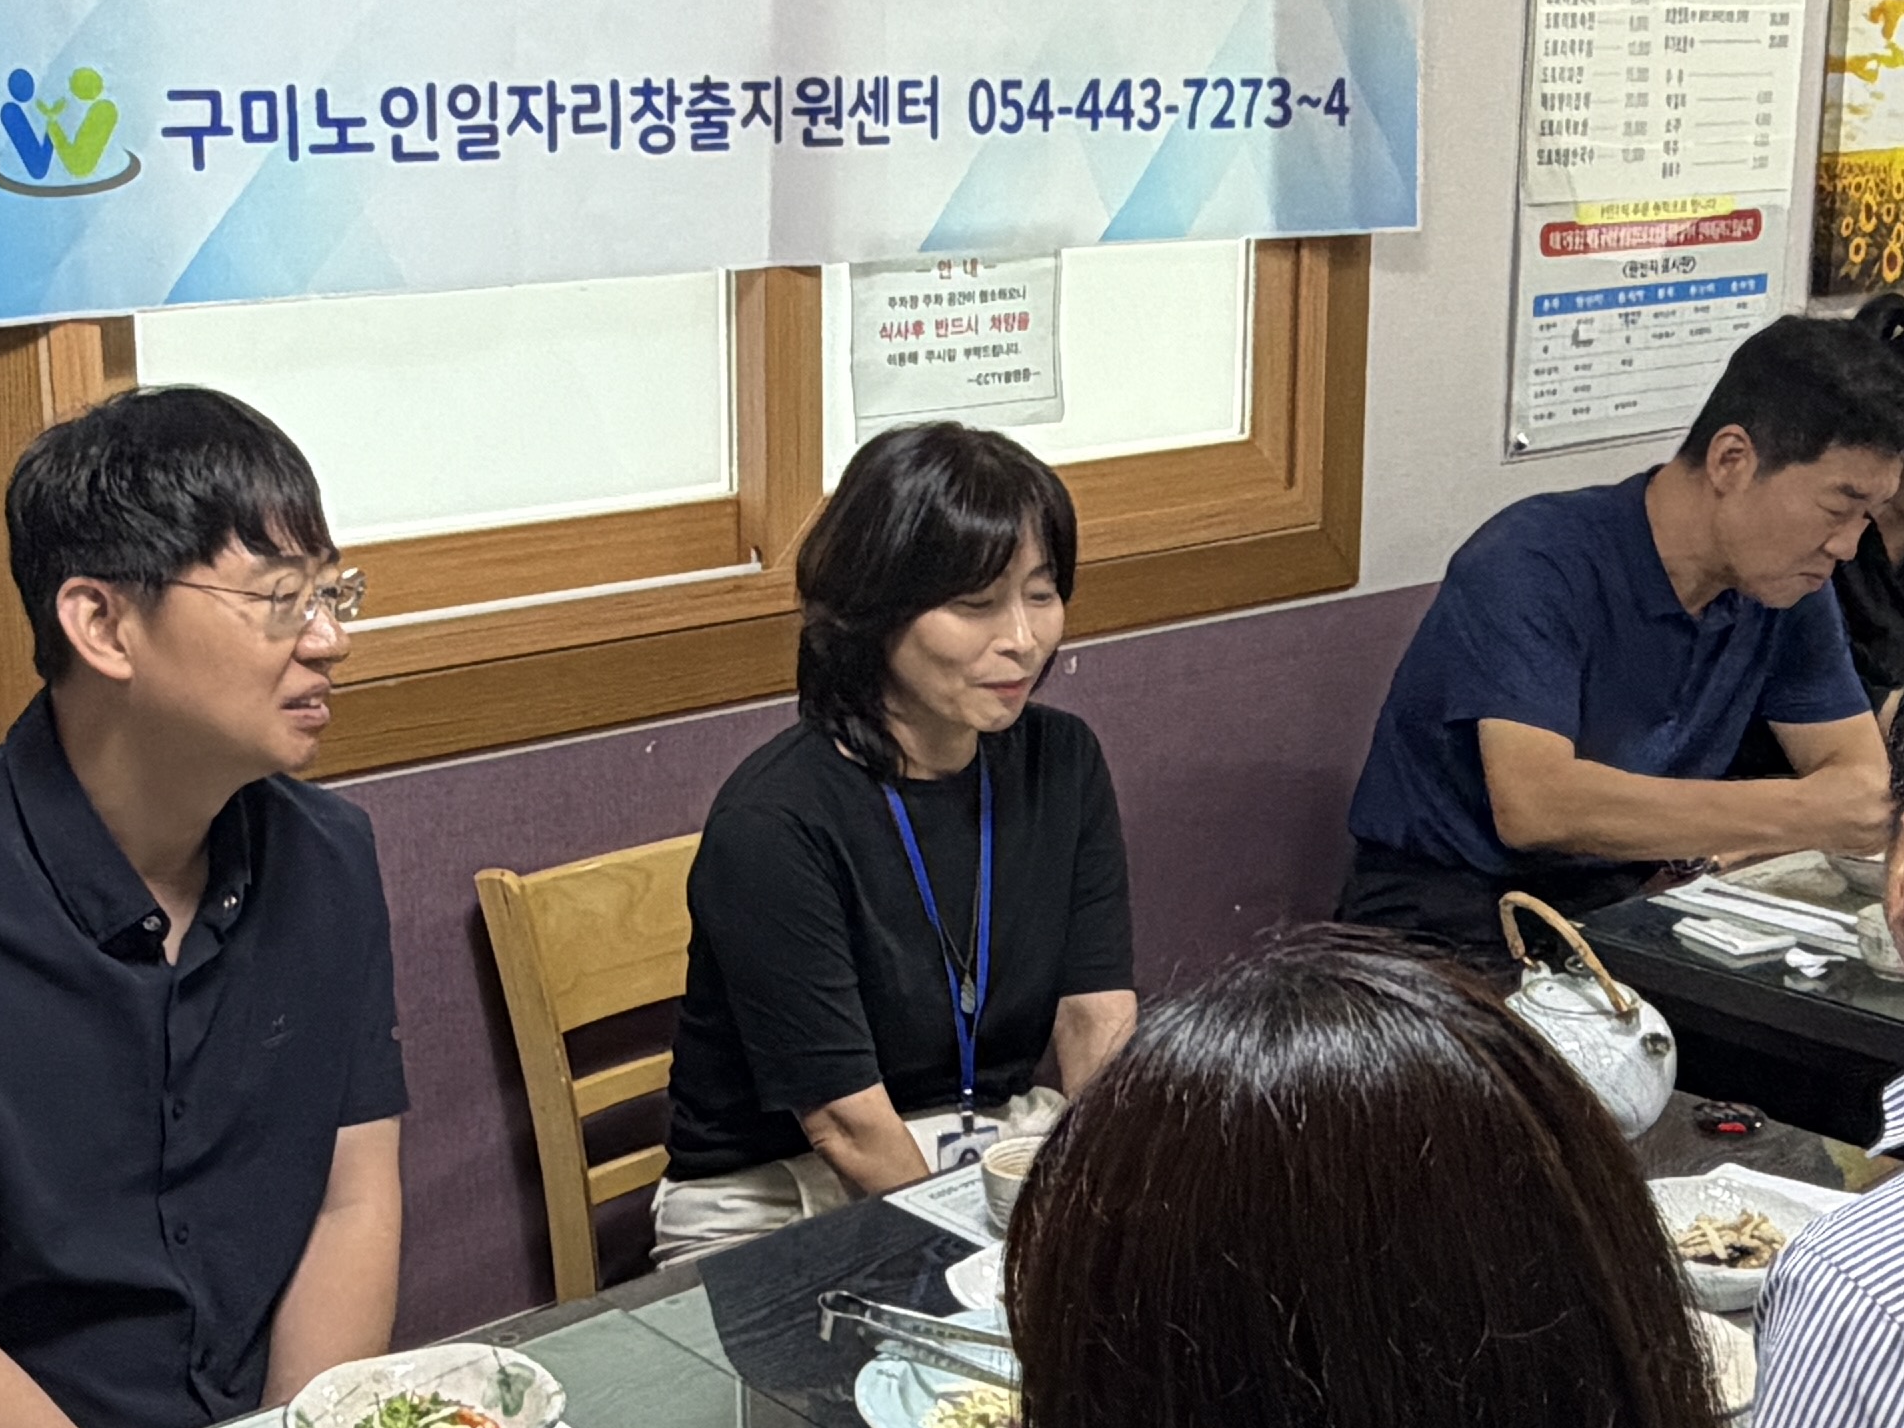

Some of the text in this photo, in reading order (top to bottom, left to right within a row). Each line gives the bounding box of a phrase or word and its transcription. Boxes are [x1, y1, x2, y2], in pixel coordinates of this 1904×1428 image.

[160, 75, 1351, 171] 구미노인일자리창출지원센터 054-443-7273~4
[888, 295, 919, 309] 주차장
[923, 293, 943, 307] 주차
[879, 311, 1030, 342] 식사후 반드시 차량을
